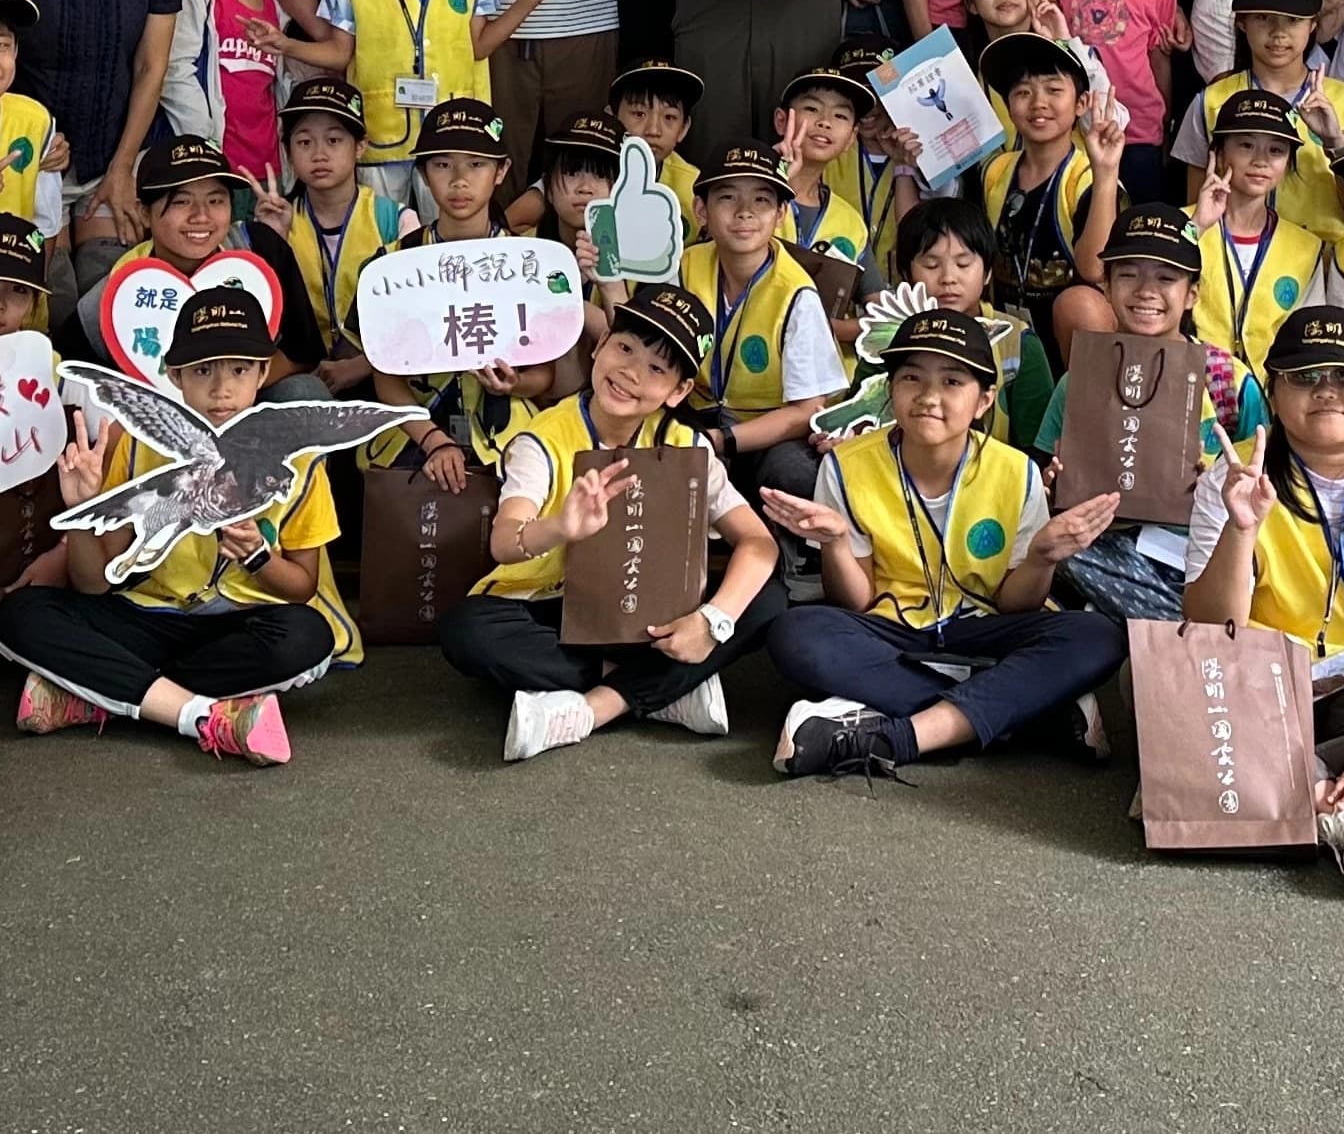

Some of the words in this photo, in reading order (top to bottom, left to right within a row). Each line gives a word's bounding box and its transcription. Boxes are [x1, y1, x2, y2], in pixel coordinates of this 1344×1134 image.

[372, 249, 542, 296] 小小解說員
[135, 286, 178, 311] 就是
